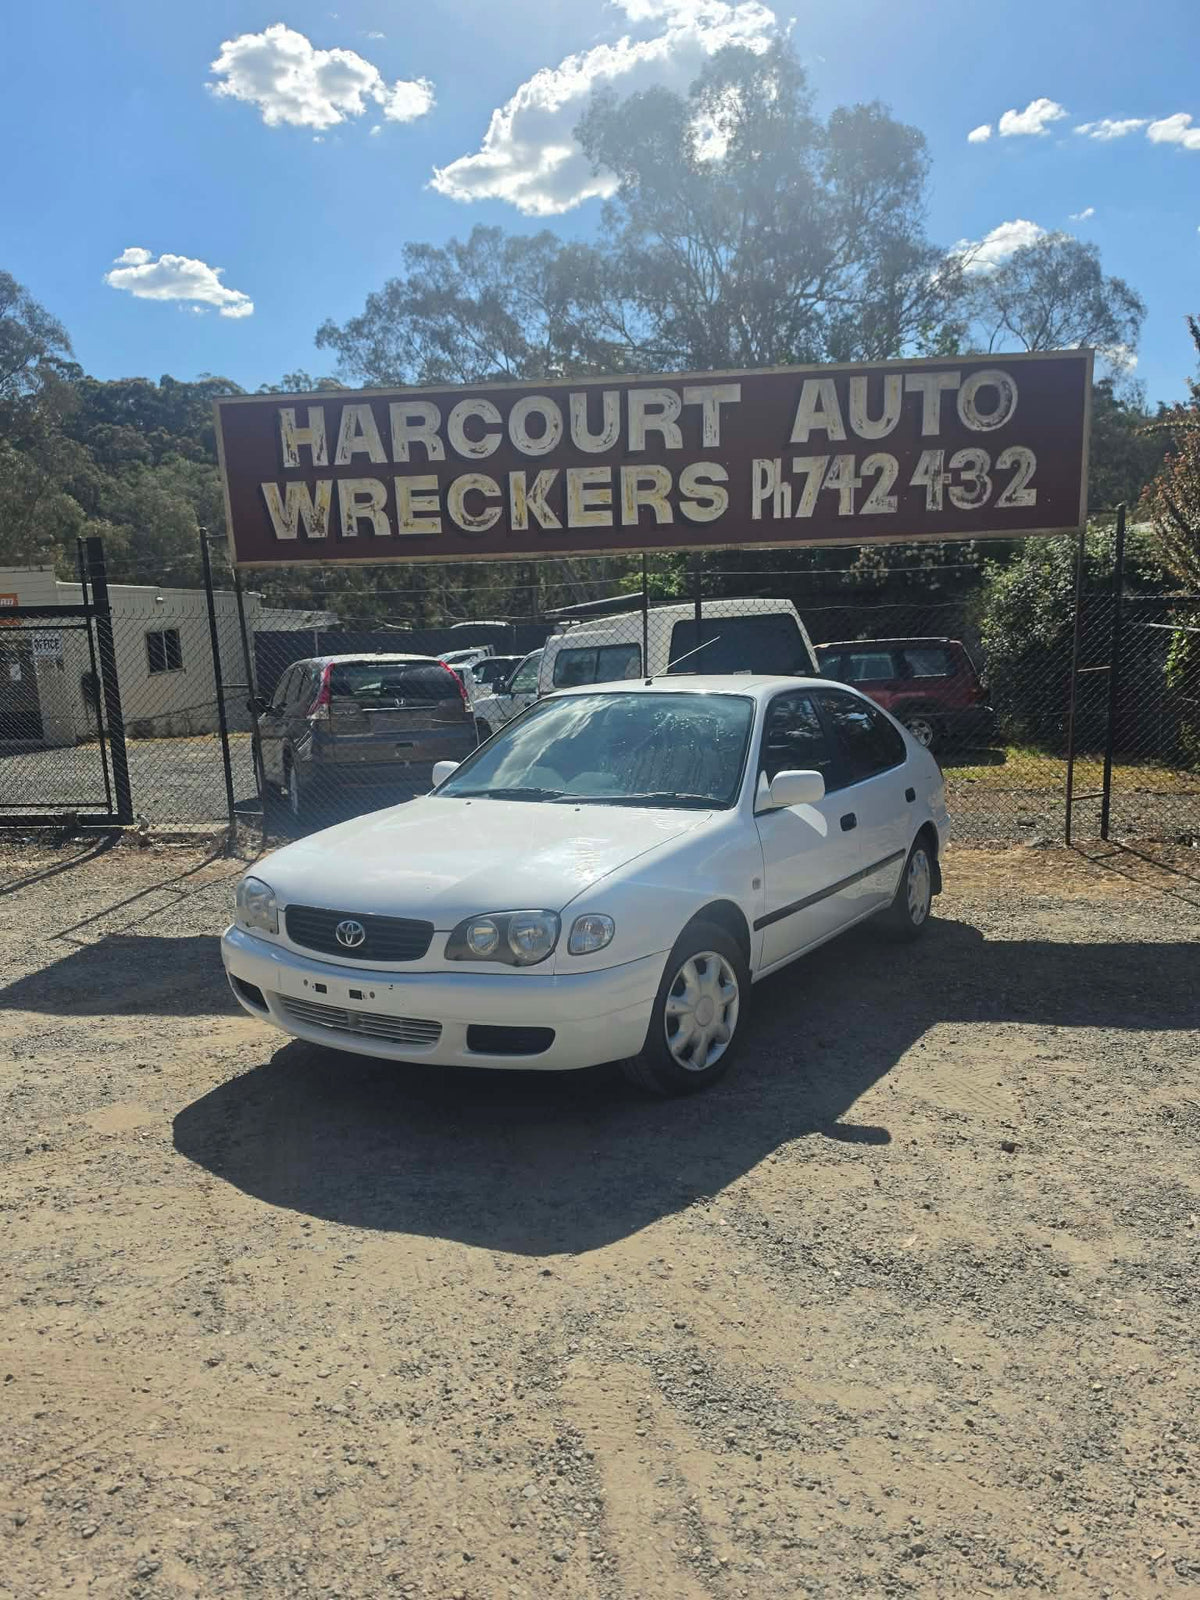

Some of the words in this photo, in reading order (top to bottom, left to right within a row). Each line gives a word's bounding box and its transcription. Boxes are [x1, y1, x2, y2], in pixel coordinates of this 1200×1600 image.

[279, 383, 742, 468] HARCOURT
[789, 369, 1019, 444] AUTO
[261, 461, 730, 540] WRECKERS
